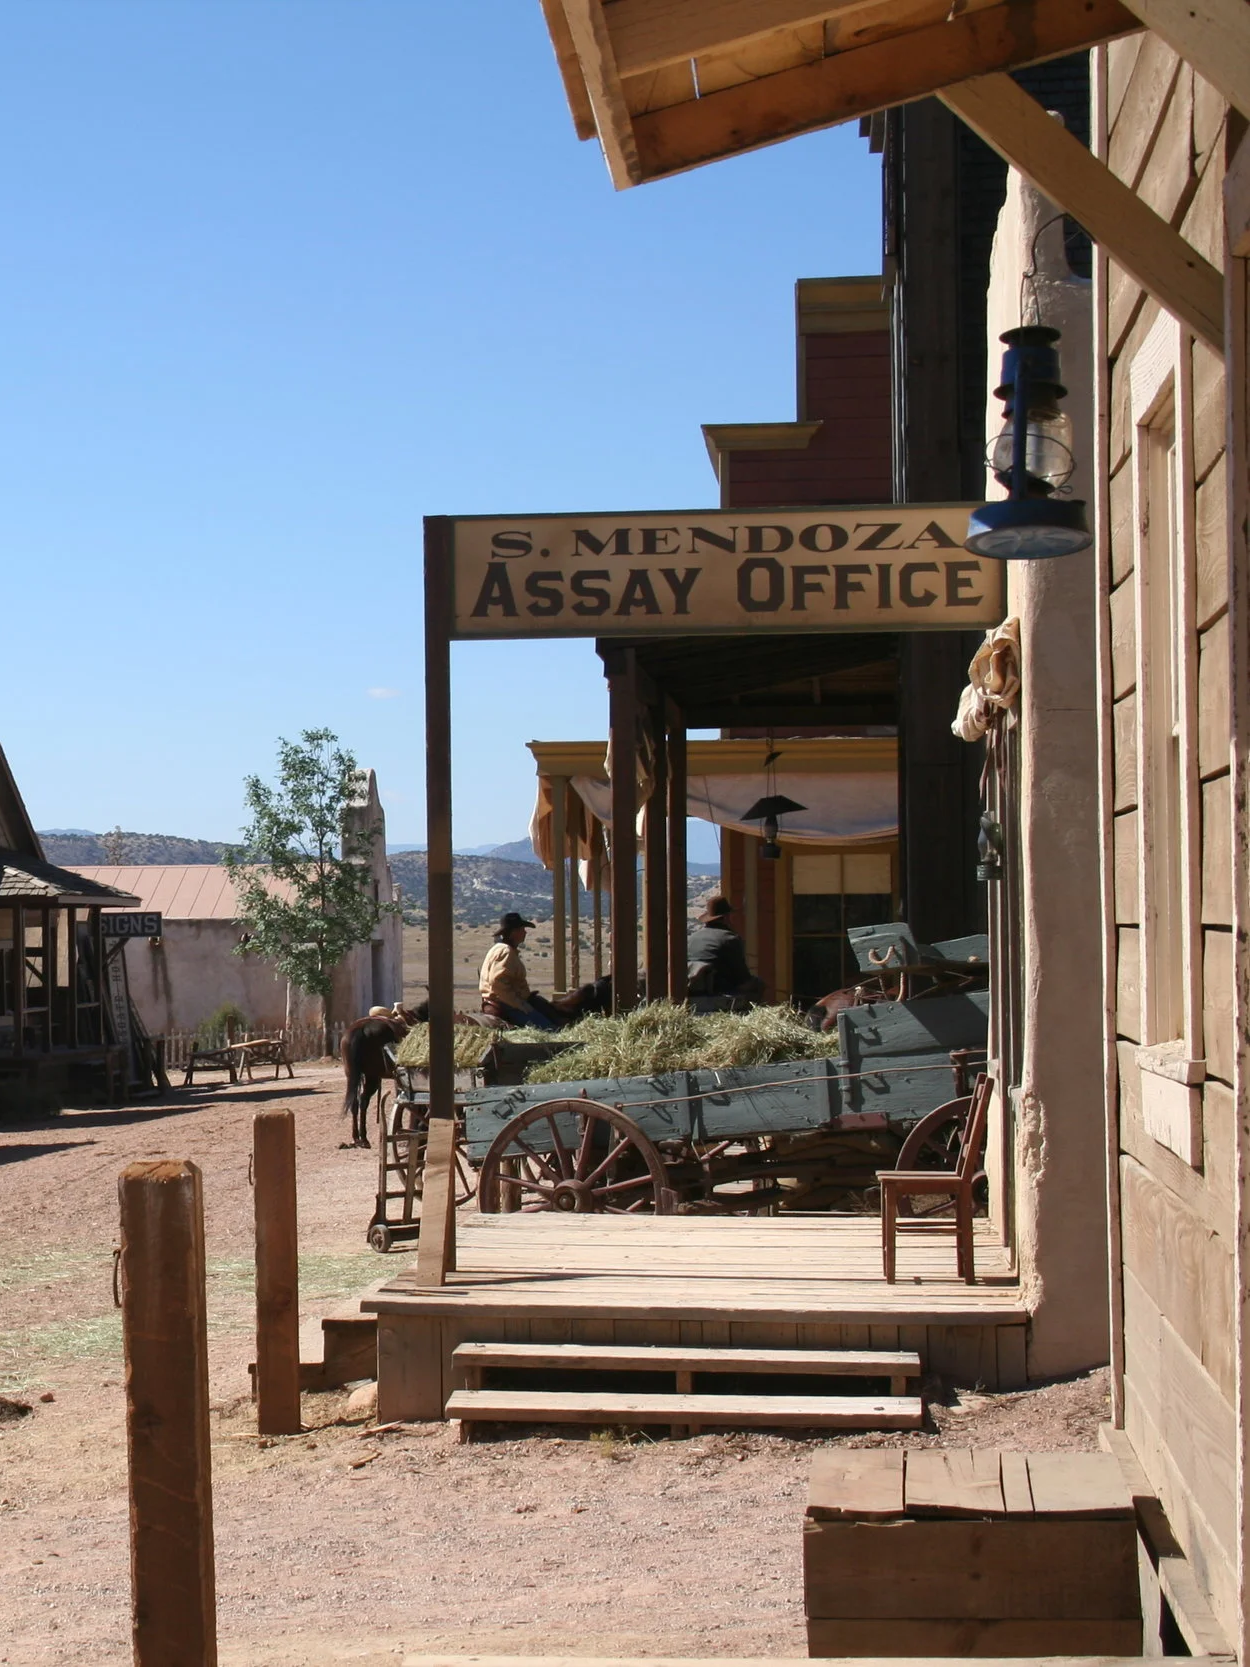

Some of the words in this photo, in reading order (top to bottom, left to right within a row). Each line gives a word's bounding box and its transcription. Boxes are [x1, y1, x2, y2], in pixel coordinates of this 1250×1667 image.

[490, 530, 550, 560] S.
[570, 520, 966, 557] MENDOZA
[469, 561, 703, 618] ASSAY
[736, 556, 985, 613] OFFICE
